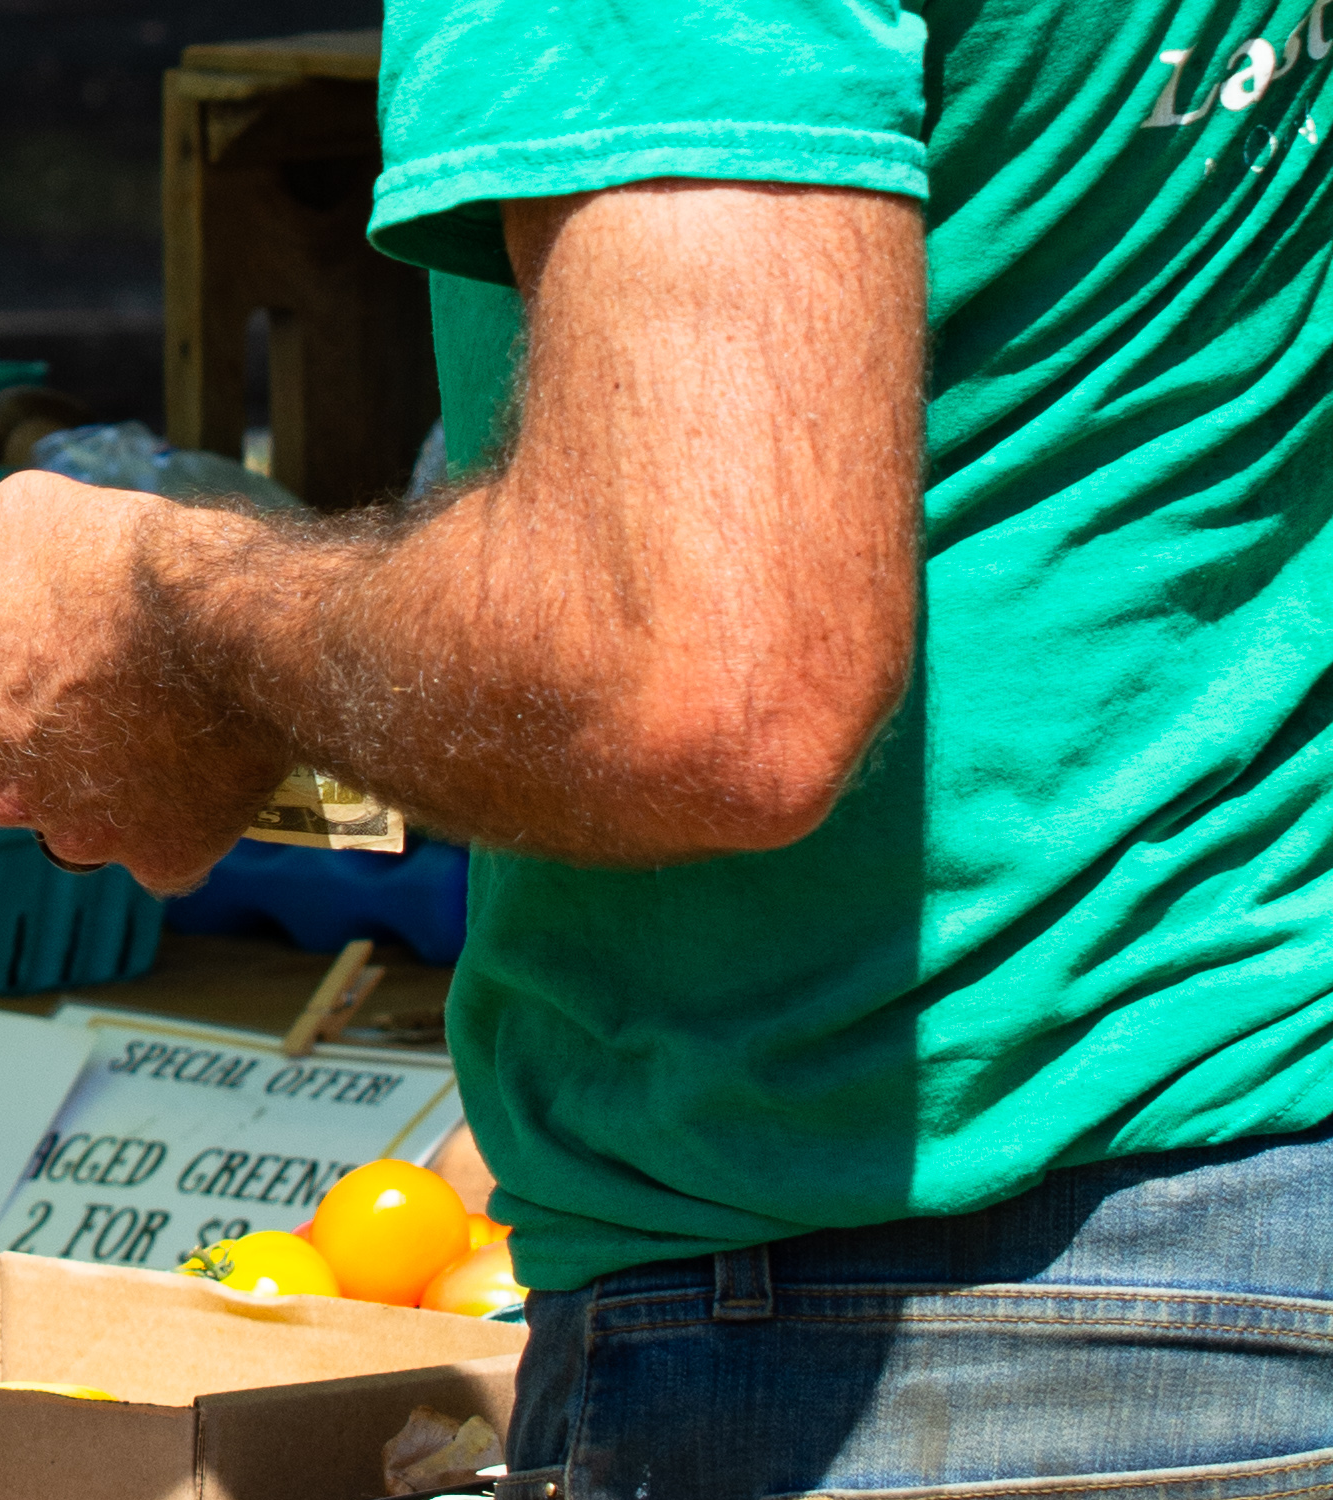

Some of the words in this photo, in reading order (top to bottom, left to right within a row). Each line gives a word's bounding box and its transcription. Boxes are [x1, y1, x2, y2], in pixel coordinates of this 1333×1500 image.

[109, 1039, 260, 1092] SPECIAL
[265, 1063, 405, 1107] OFFER!
[9, 1200, 53, 1254] 2
[59, 1203, 171, 1265] FOR
